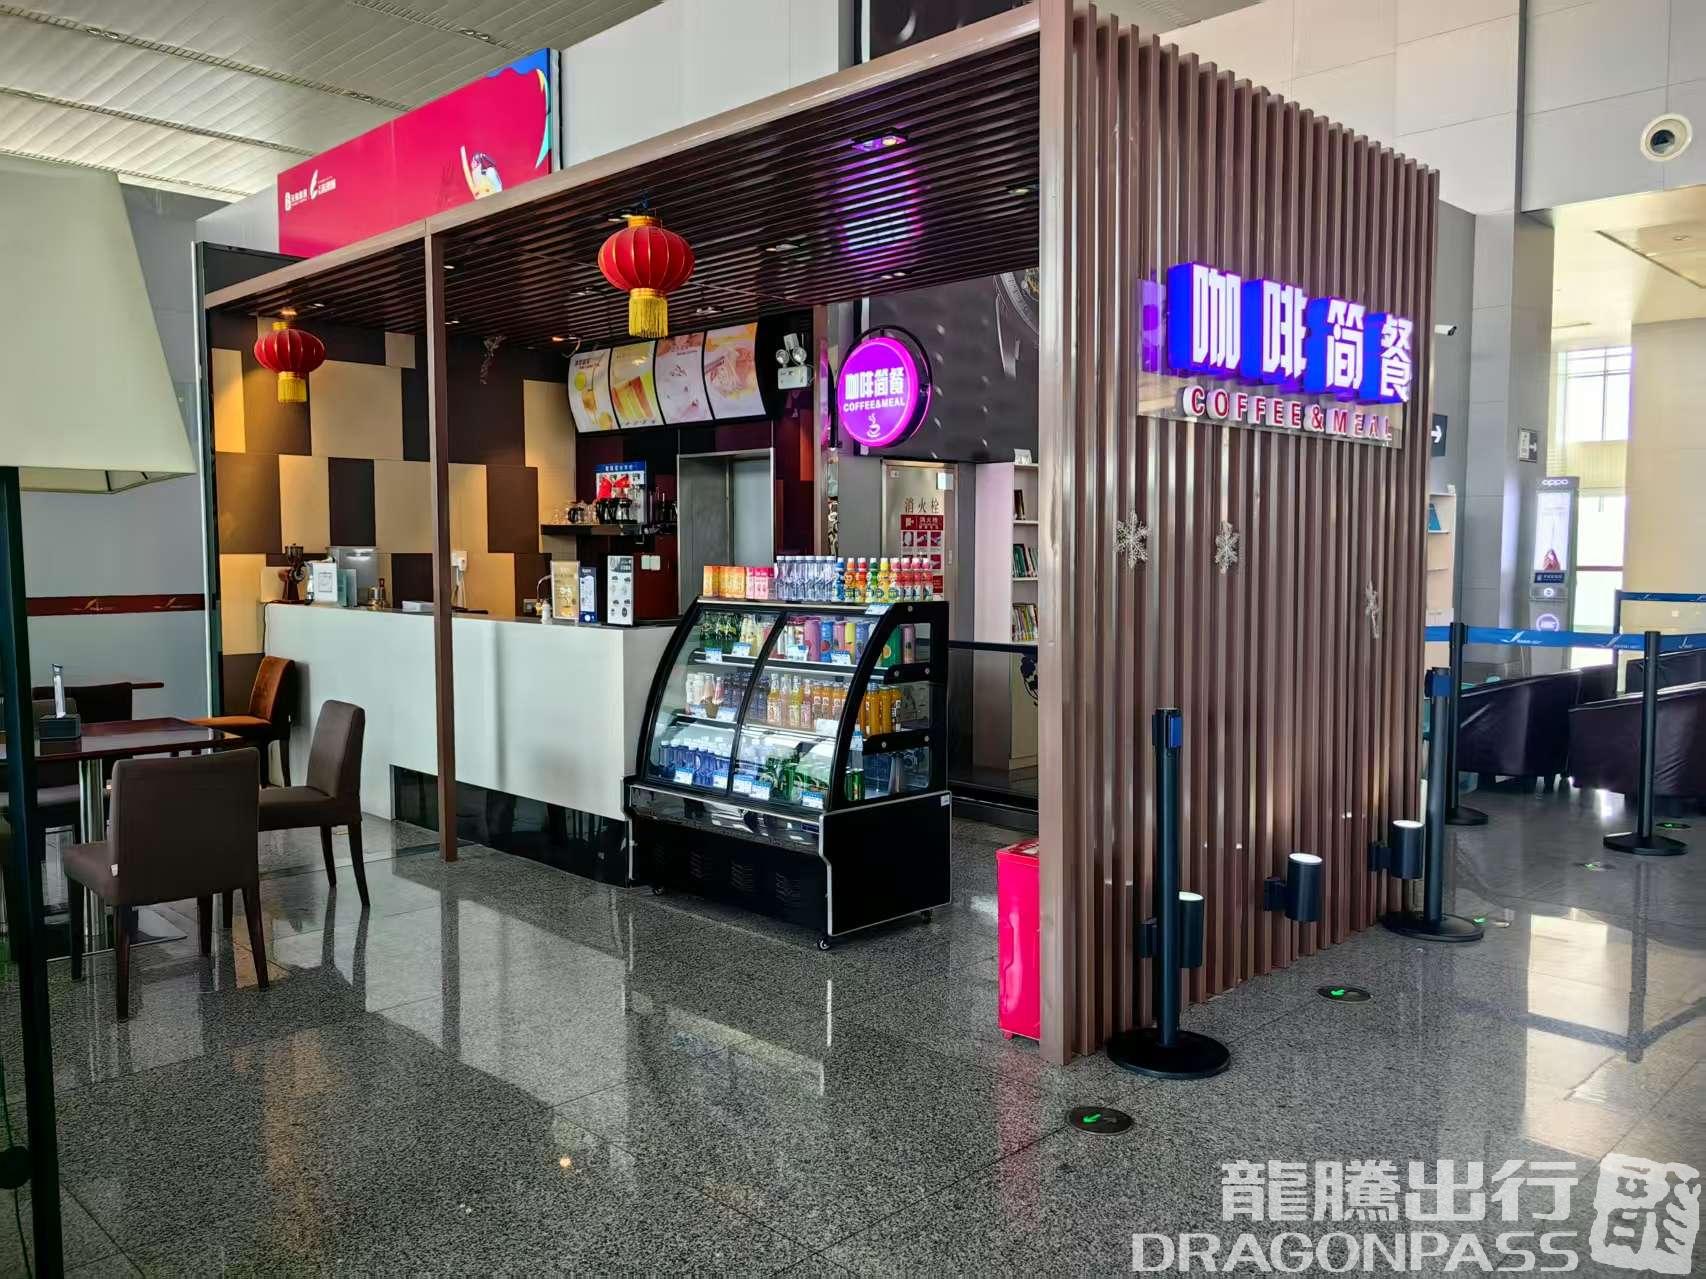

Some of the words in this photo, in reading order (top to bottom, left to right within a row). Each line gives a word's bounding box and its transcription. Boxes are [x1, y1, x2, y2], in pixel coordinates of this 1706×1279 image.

[1191, 263, 1413, 402] 咖啡简餐
[843, 396, 906, 413] COFFEE&MEAL
[903, 496, 940, 514] 消火栓
